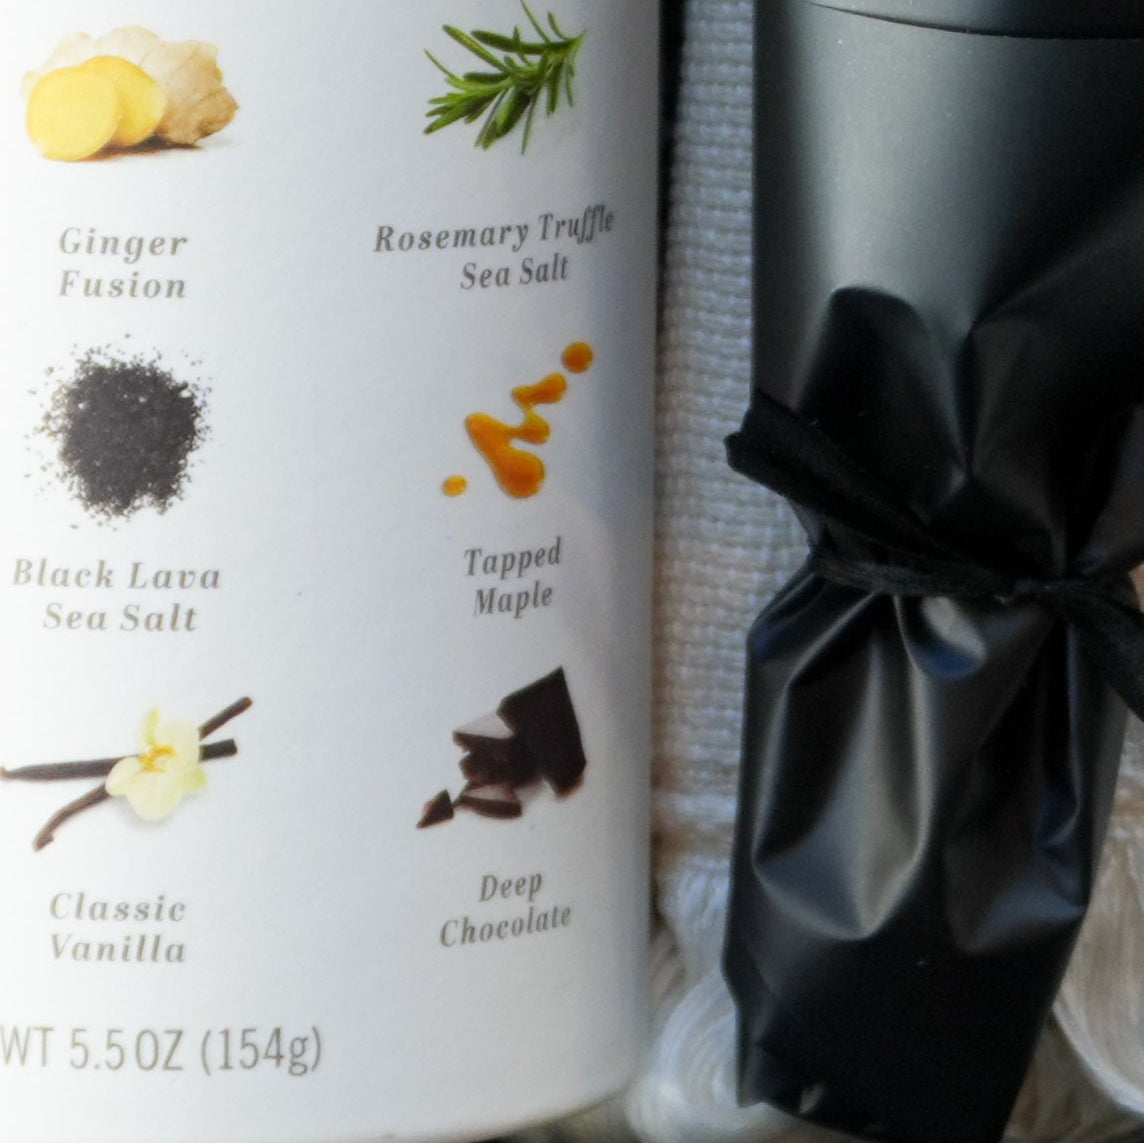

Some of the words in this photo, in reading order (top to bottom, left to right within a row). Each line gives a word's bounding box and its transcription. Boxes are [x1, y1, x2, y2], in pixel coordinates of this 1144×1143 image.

[58, 225, 190, 266] Ginger
[373, 221, 530, 255] Rosemary
[538, 203, 616, 246] Truffle
[58, 269, 188, 299] Fusion
[459, 261, 512, 291] Sea
[518, 252, 570, 286] Salt
[12, 558, 115, 590] Black
[128, 561, 222, 591] Lava
[463, 535, 563, 578] Tapped
[42, 602, 108, 631] Sea
[119, 602, 198, 633] Salt
[473, 579, 554, 620] Maple
[478, 870, 543, 904] Deep
[49, 892, 188, 923] Classic
[439, 901, 572, 949] Chocolate
[49, 932, 187, 964] Vanilla
[0, 1024, 55, 1067] WT
[200, 1024, 324, 1079] (154g)
